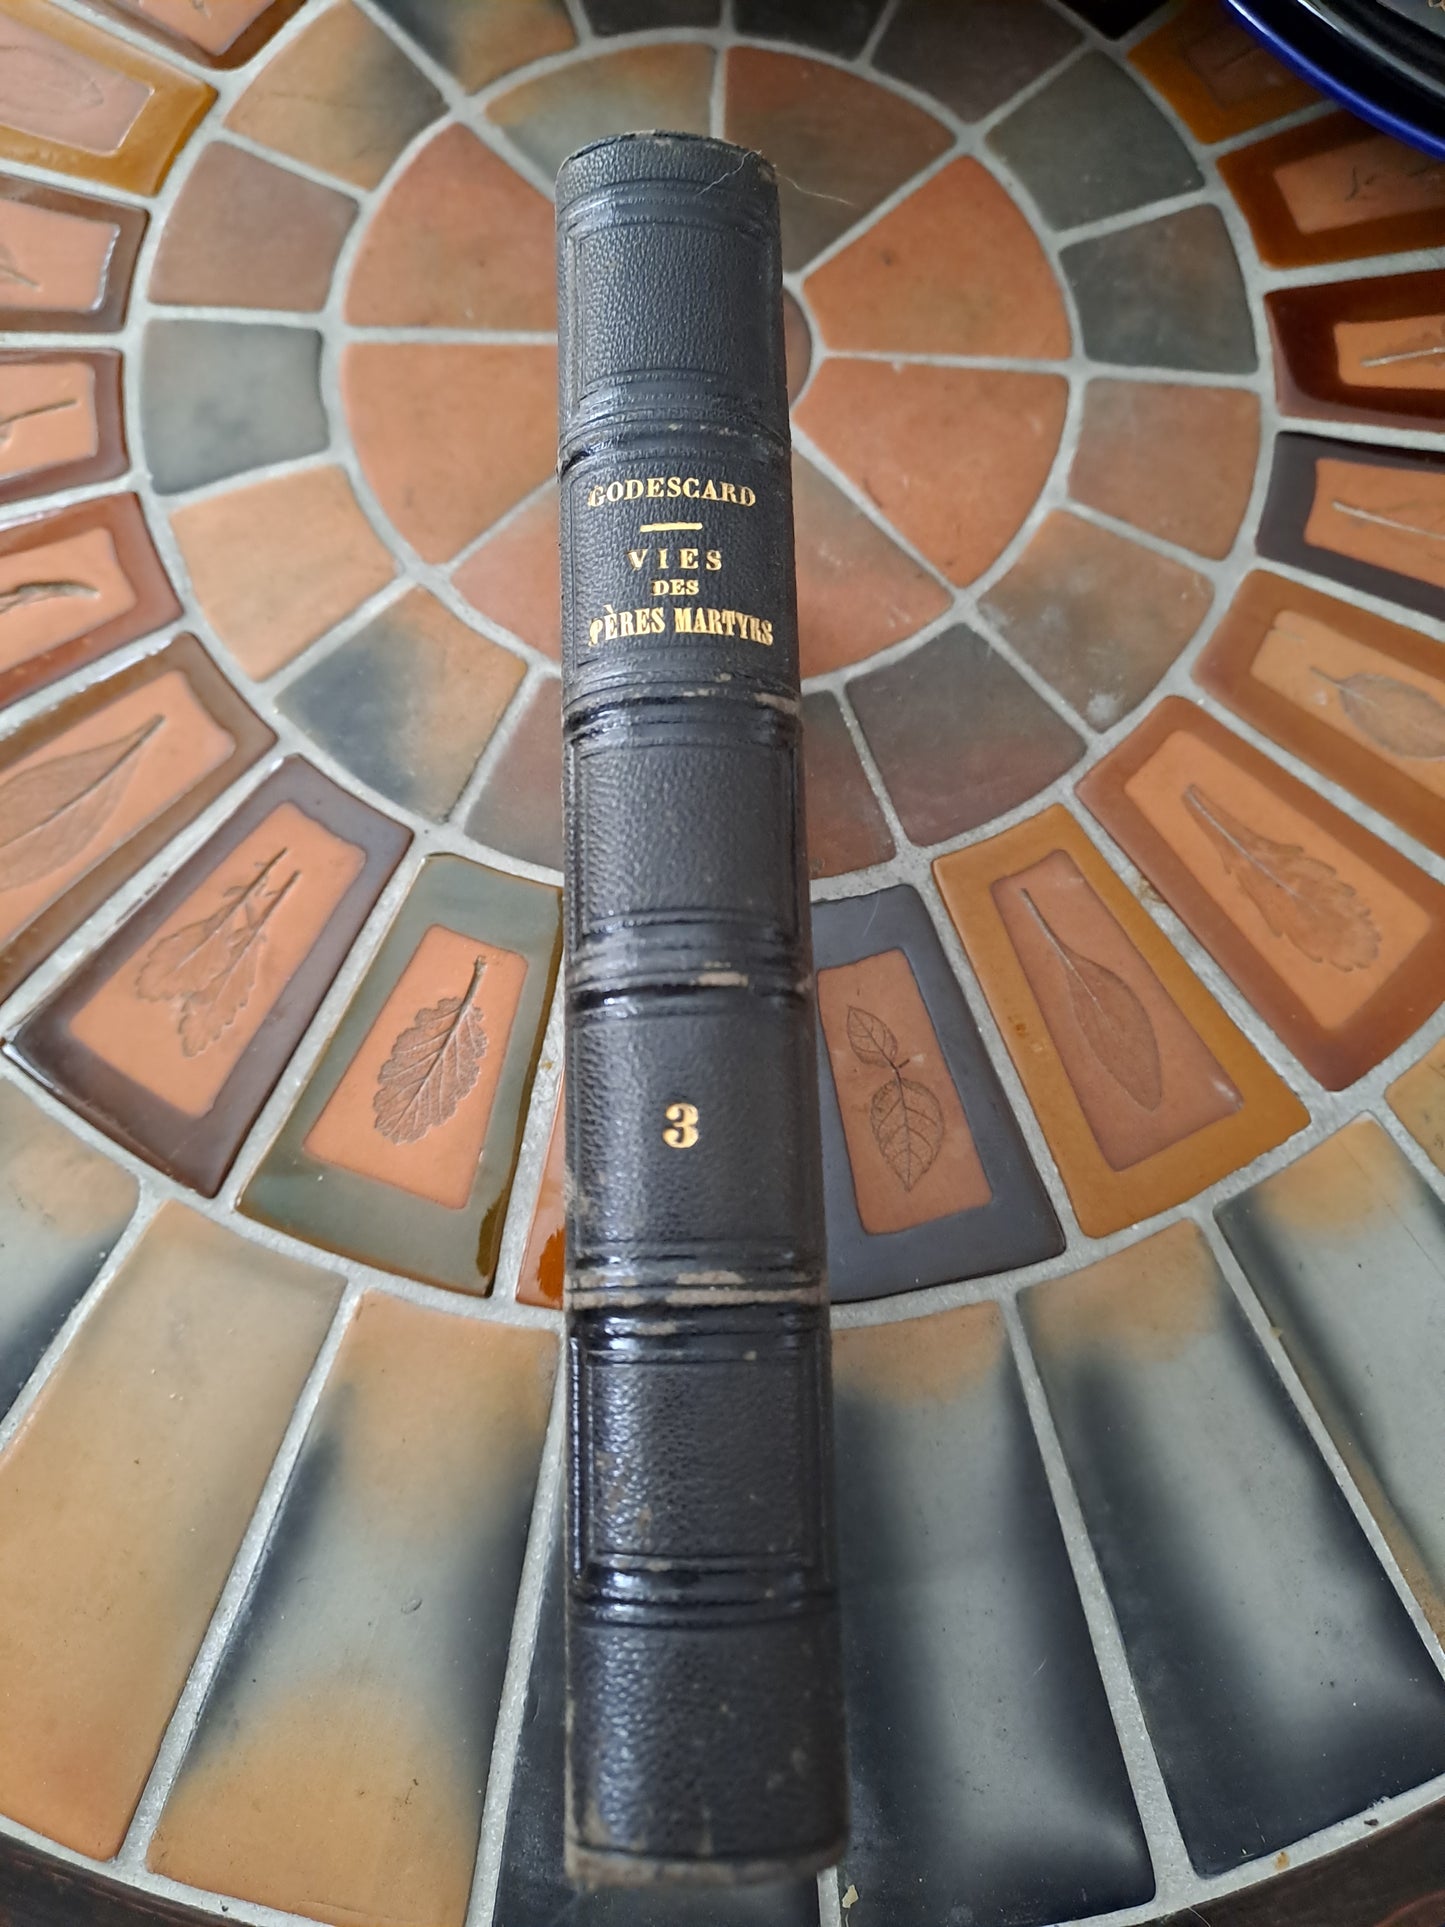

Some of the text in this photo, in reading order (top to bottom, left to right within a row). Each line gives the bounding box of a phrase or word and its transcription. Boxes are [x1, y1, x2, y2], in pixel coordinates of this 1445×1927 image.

[588, 476, 756, 507] GODESCARD
[627, 548, 722, 571] VIES
[652, 578, 699, 596] DES
[588, 604, 774, 647] PÈRES MARTYRS
[662, 1102, 699, 1149] 3
